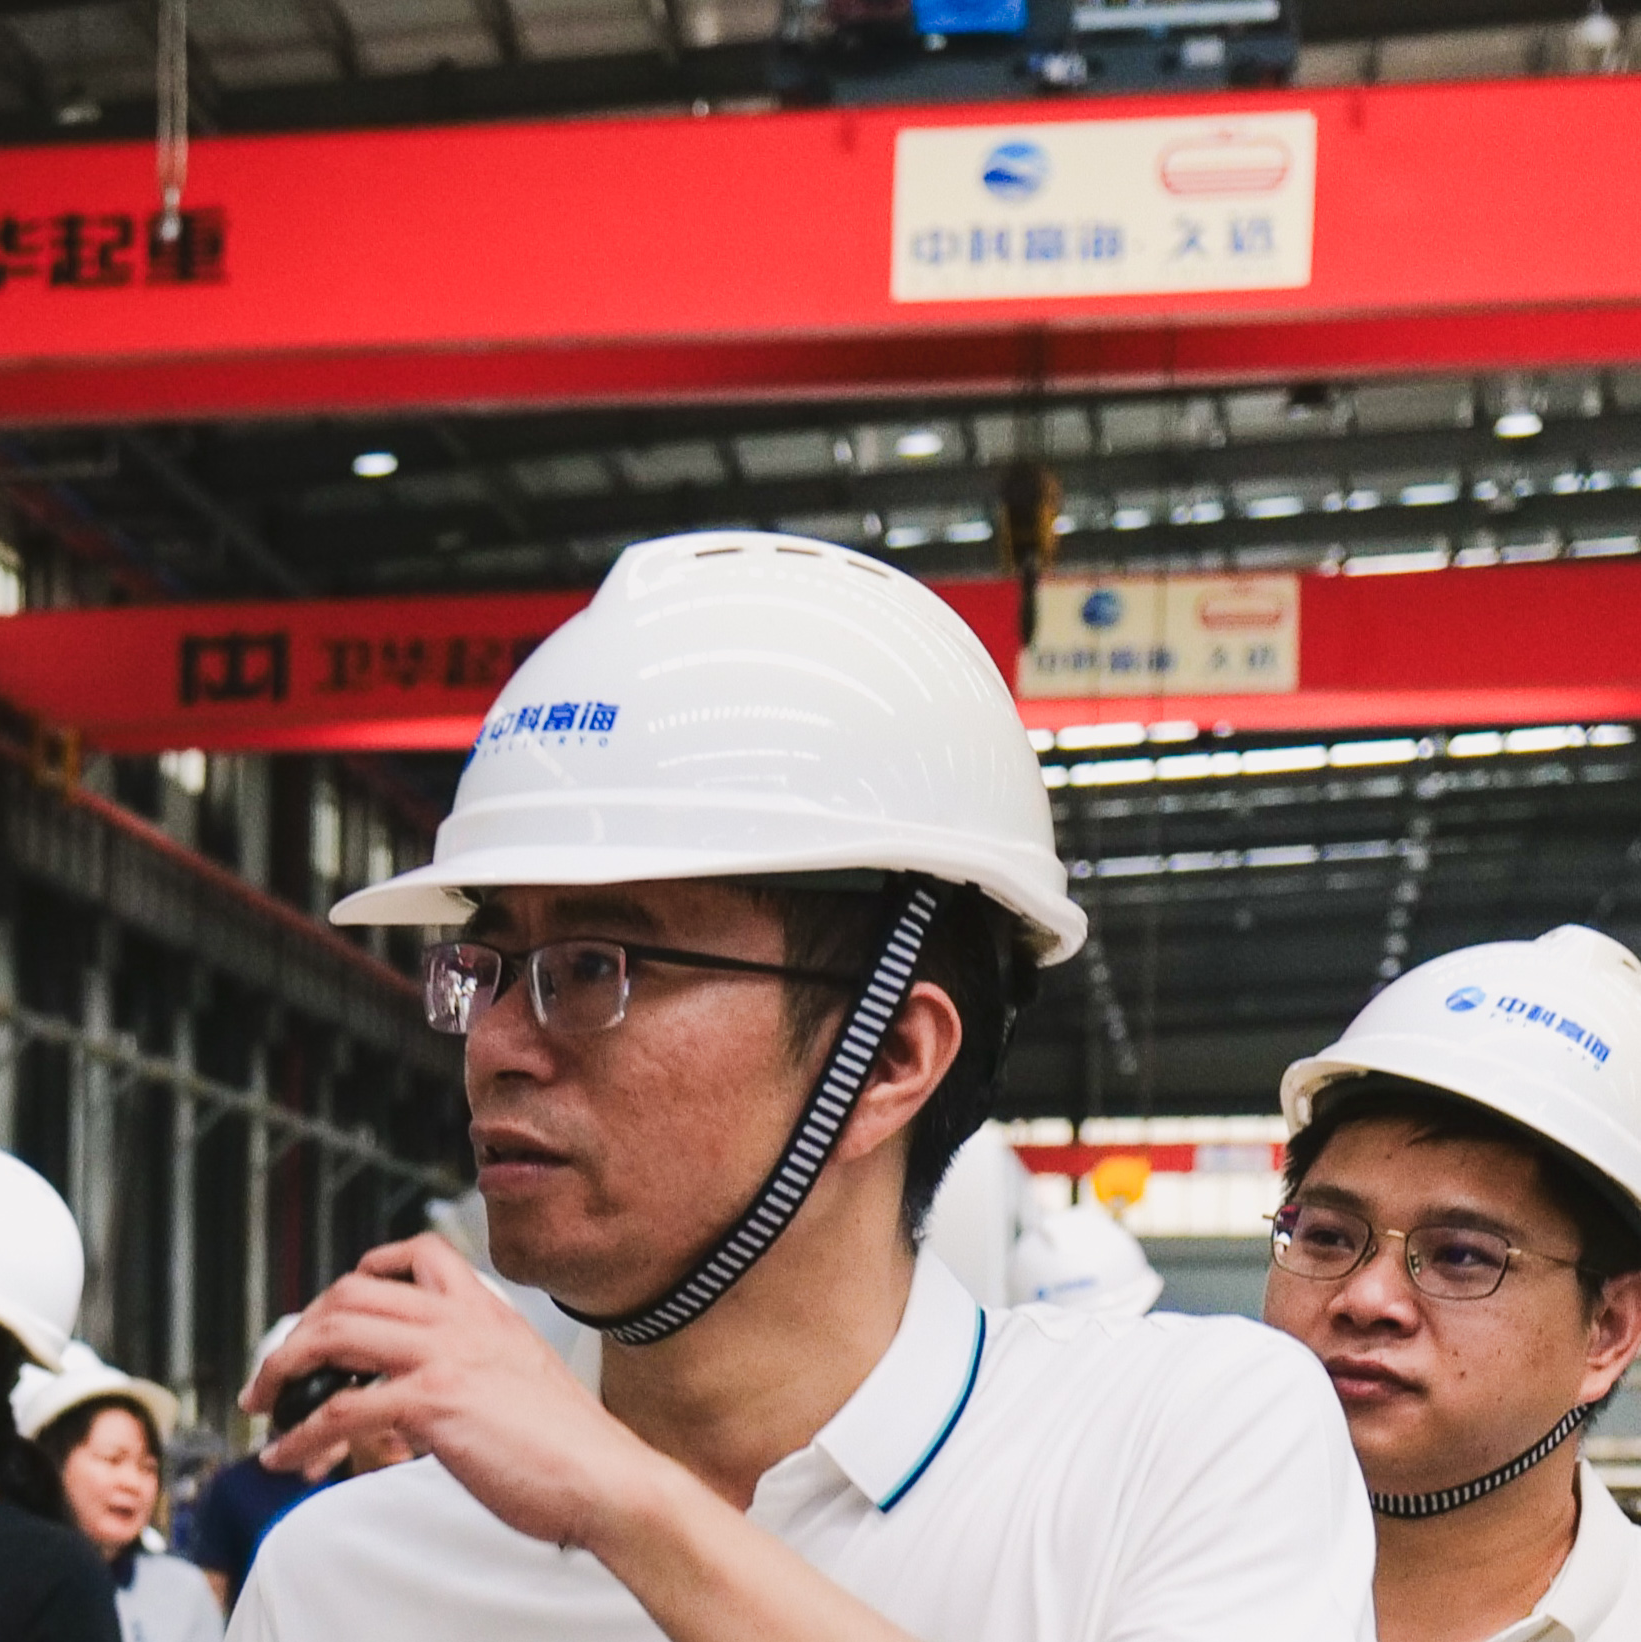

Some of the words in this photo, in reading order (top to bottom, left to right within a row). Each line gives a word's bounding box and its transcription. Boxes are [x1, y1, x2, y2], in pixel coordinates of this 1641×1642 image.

[489, 701, 619, 741] 中科富海
[1496, 996, 1611, 1063] 中科富海
